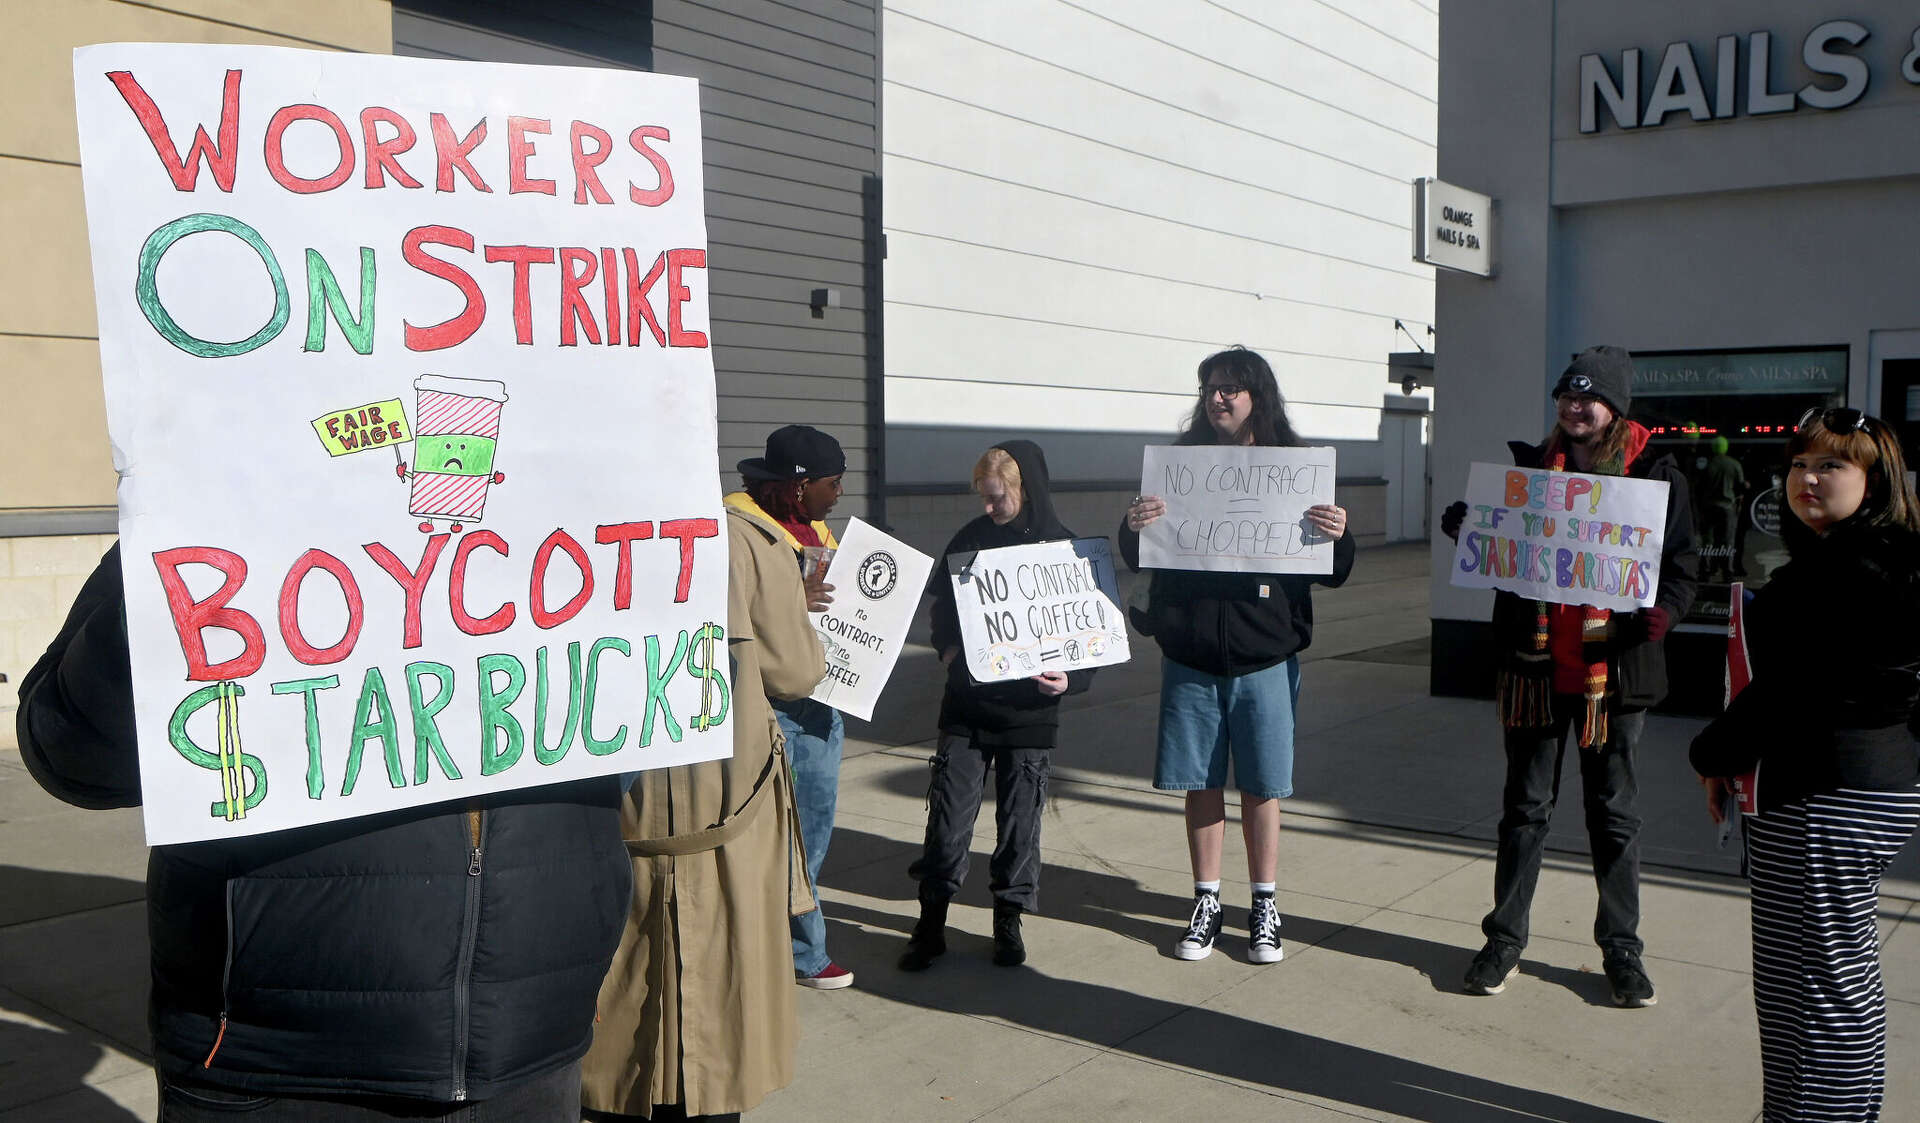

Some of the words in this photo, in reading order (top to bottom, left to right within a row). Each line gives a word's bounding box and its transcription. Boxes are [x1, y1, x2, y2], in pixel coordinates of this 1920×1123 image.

[1579, 20, 1871, 133] NAILS
[105, 68, 676, 207] WORKERS
[1443, 206, 1473, 227] ORANGE
[1437, 227, 1457, 245] NAILS
[1458, 232, 1465, 247] &
[1466, 234, 1480, 250] SPA
[135, 212, 378, 358] ON
[401, 224, 709, 353] STRIKE
[1676, 369, 1700, 382] SPA
[1750, 367, 1791, 380] NAILS
[1801, 366, 1828, 380] SPA
[325, 406, 384, 438] FAIR
[338, 421, 402, 450] WAGE
[1165, 464, 1194, 496] NO
[1206, 463, 1329, 496] CONTRACT
[1505, 470, 1602, 514] BEEP!
[1176, 520, 1315, 557] CHOPPED!
[1473, 504, 1509, 529] IF
[1522, 511, 1556, 537] YOU
[1567, 517, 1652, 547] SUPPORT
[974, 568, 1008, 605] NO
[1556, 548, 1650, 600] BARISTAS
[151, 517, 719, 682] BOYCOTT
[855, 608, 868, 621] no
[820, 614, 884, 655] CONTRACT.
[983, 610, 1018, 644] NO
[837, 647, 850, 660] no
[168, 621, 730, 821] $TARBUCK$
